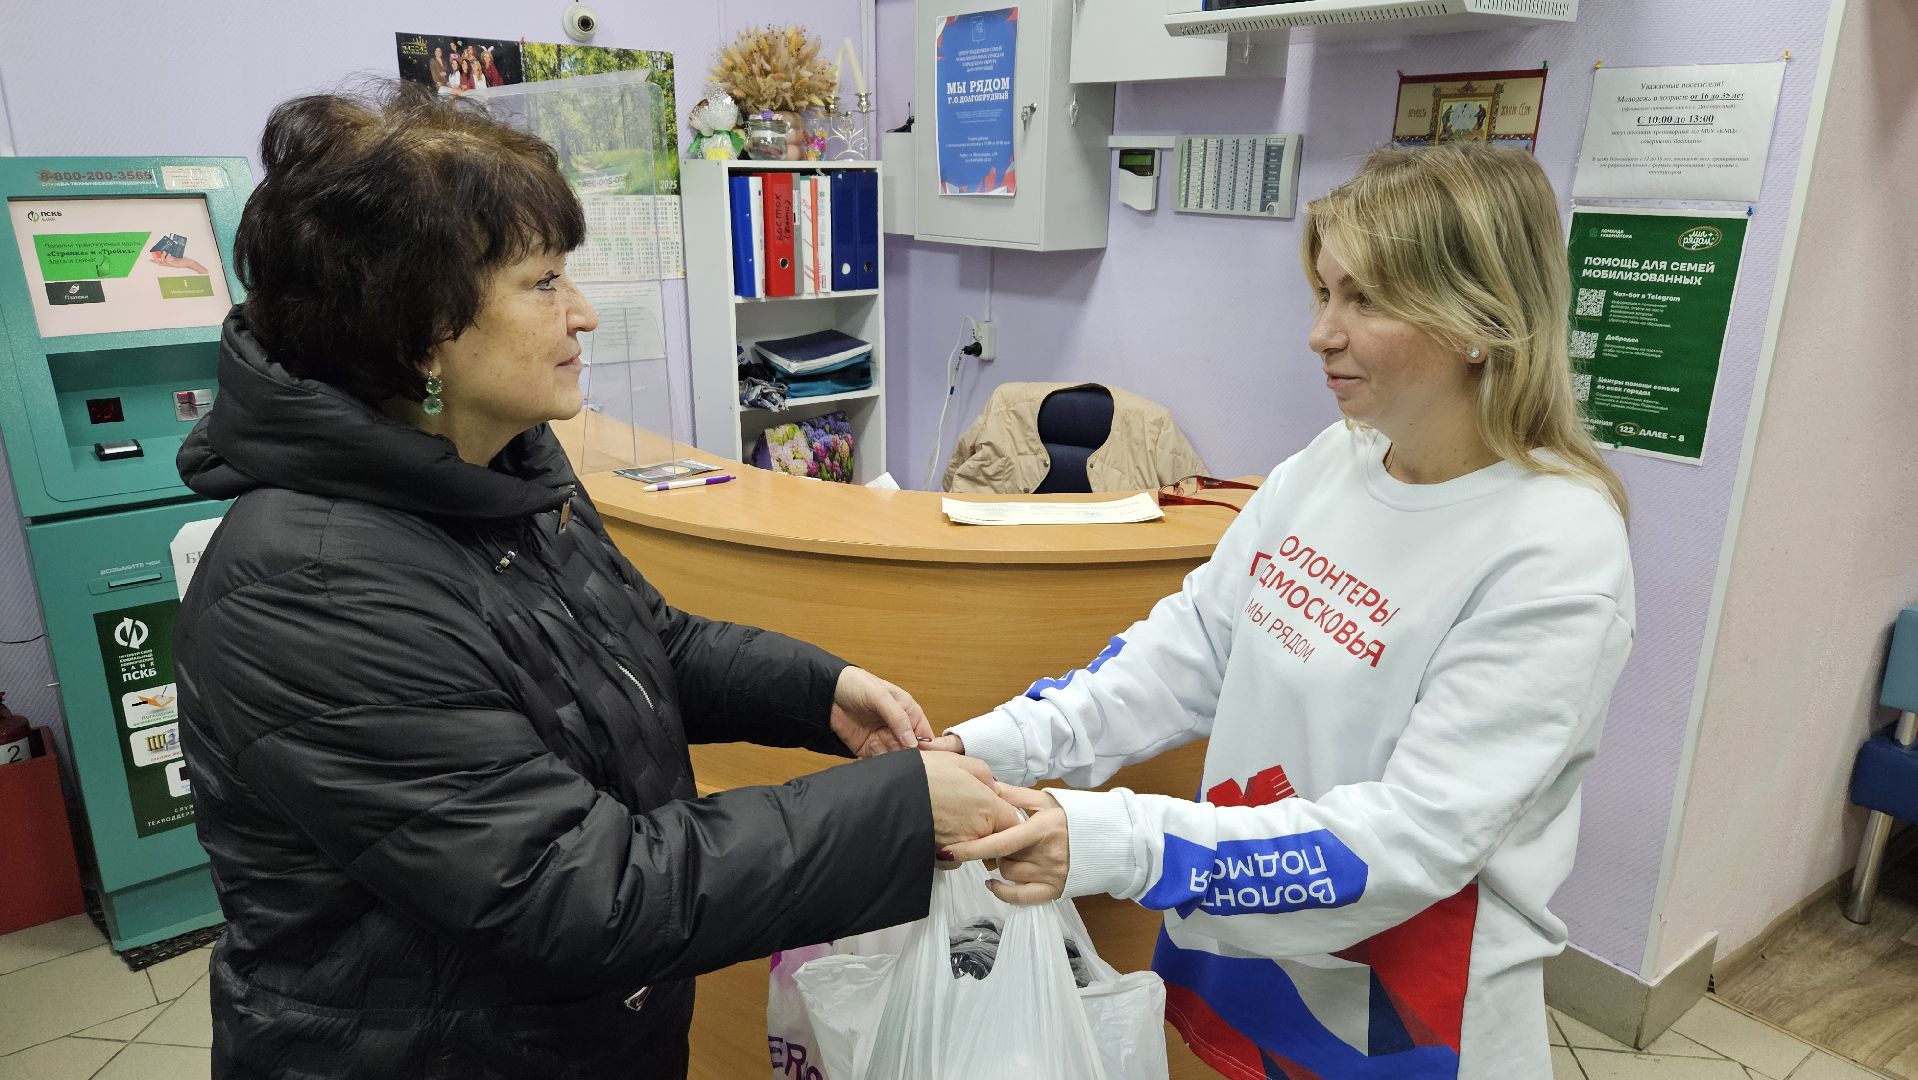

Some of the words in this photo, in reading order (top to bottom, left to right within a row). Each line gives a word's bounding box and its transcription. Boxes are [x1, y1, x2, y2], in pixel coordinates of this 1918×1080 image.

[946, 81, 966, 94] МЫ
[969, 77, 1010, 93] РЯДОМ
[1640, 82, 1680, 91] Уважаемые
[1637, 116, 1645, 124] С
[1648, 115, 1672, 124] 10:00
[1674, 116, 1685, 125] до
[1689, 114, 1714, 123] 13:00
[660, 180, 678, 189] 2025
[1584, 256, 1640, 269] ПОМОЩЬ
[1641, 260, 1668, 271] ДЛЯ
[1670, 261, 1716, 273] СЕМЕЙ
[1581, 268, 1703, 286] МОБИЛИЗОВАННЫХ
[1613, 290, 1640, 298] Чат-бот
[1647, 292, 1681, 302] Telegram
[1605, 334, 1639, 343] Добродел
[1598, 376, 1624, 387] Центры
[1653, 385, 1680, 393] семьям
[1623, 387, 1651, 397] городах
[1638, 428, 1668, 440] ДАЛЕЕ
[1678, 434, 1685, 442] 8
[100, 561, 144, 575] ВОЗЬМИТЕ
[1280, 535, 1400, 627] ОЛОНТЕРЫ
[1244, 598, 1272, 627] МЫ
[1267, 617, 1316, 664] РЯДОМ
[122, 667, 157, 682] ПСКБ
[8, 745, 22, 764] 2
[174, 804, 194, 813] СЛУЖ
[148, 810, 195, 827] ТЕХПОДДЕРЖ
